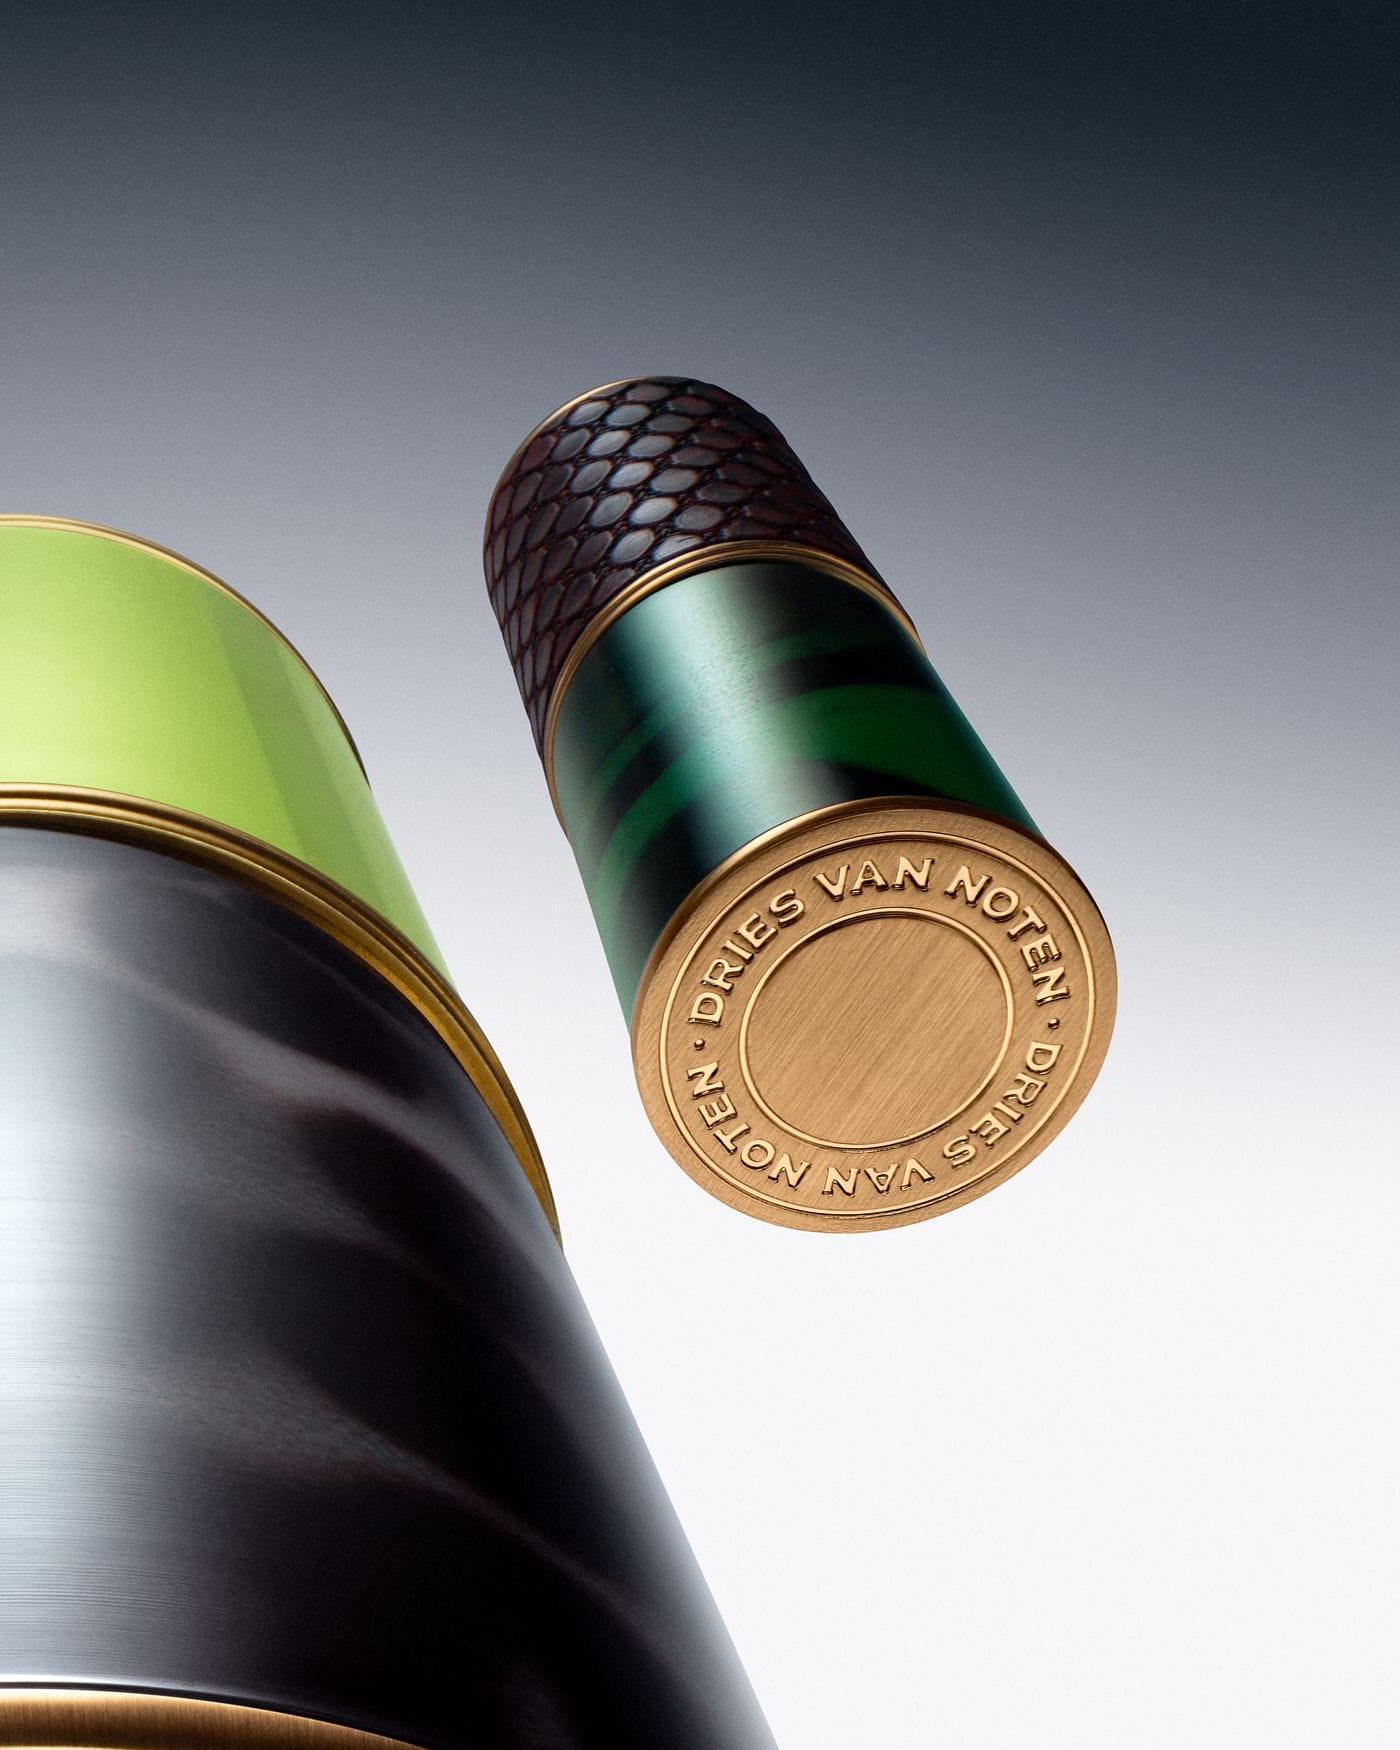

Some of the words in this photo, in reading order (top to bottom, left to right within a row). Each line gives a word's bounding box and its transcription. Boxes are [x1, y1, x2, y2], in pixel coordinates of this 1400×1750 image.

[688, 889, 805, 1026] DRIES
[813, 856, 934, 901] VAN
[944, 865, 1070, 1006] NOTEN
[687, 1061, 812, 1189] NOTEN
[943, 1042, 1062, 1167] DRIES
[822, 1163, 934, 1197] VAN
